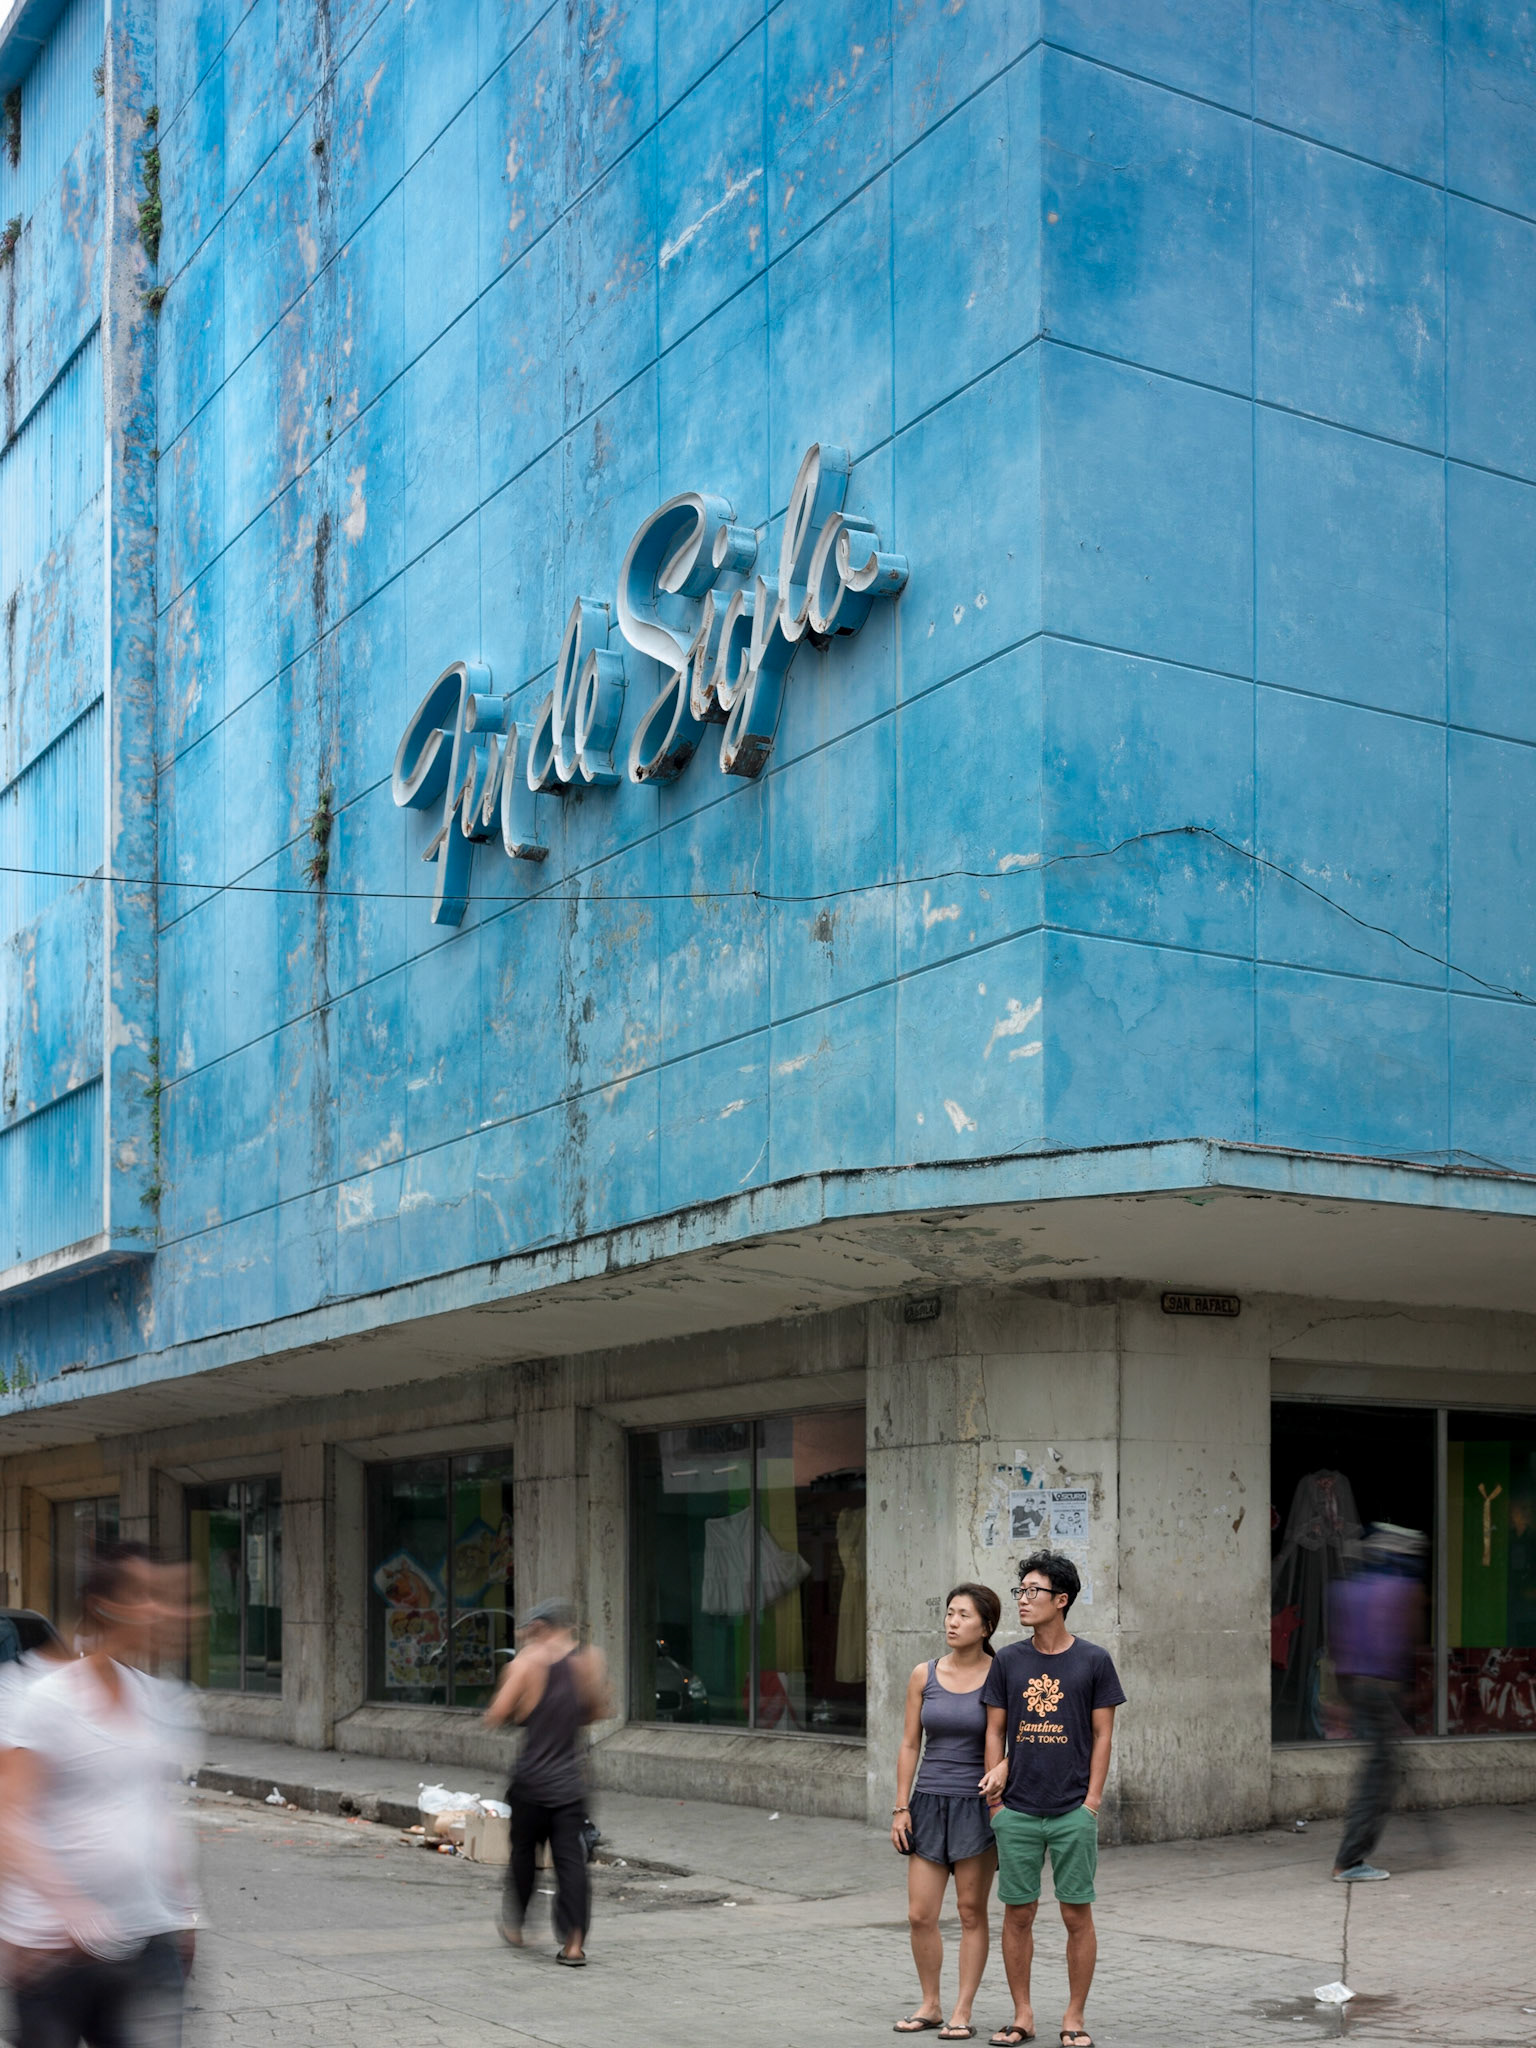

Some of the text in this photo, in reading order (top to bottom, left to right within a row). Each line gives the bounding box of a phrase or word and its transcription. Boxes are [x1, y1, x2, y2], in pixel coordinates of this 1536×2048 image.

[393, 442, 910, 926] Fin de Siglo
[1168, 1296, 1233, 1312] SAN RAFAEL
[1019, 1720, 1064, 1735] Ganthree
[1037, 1735, 1068, 1744] TOKYO
